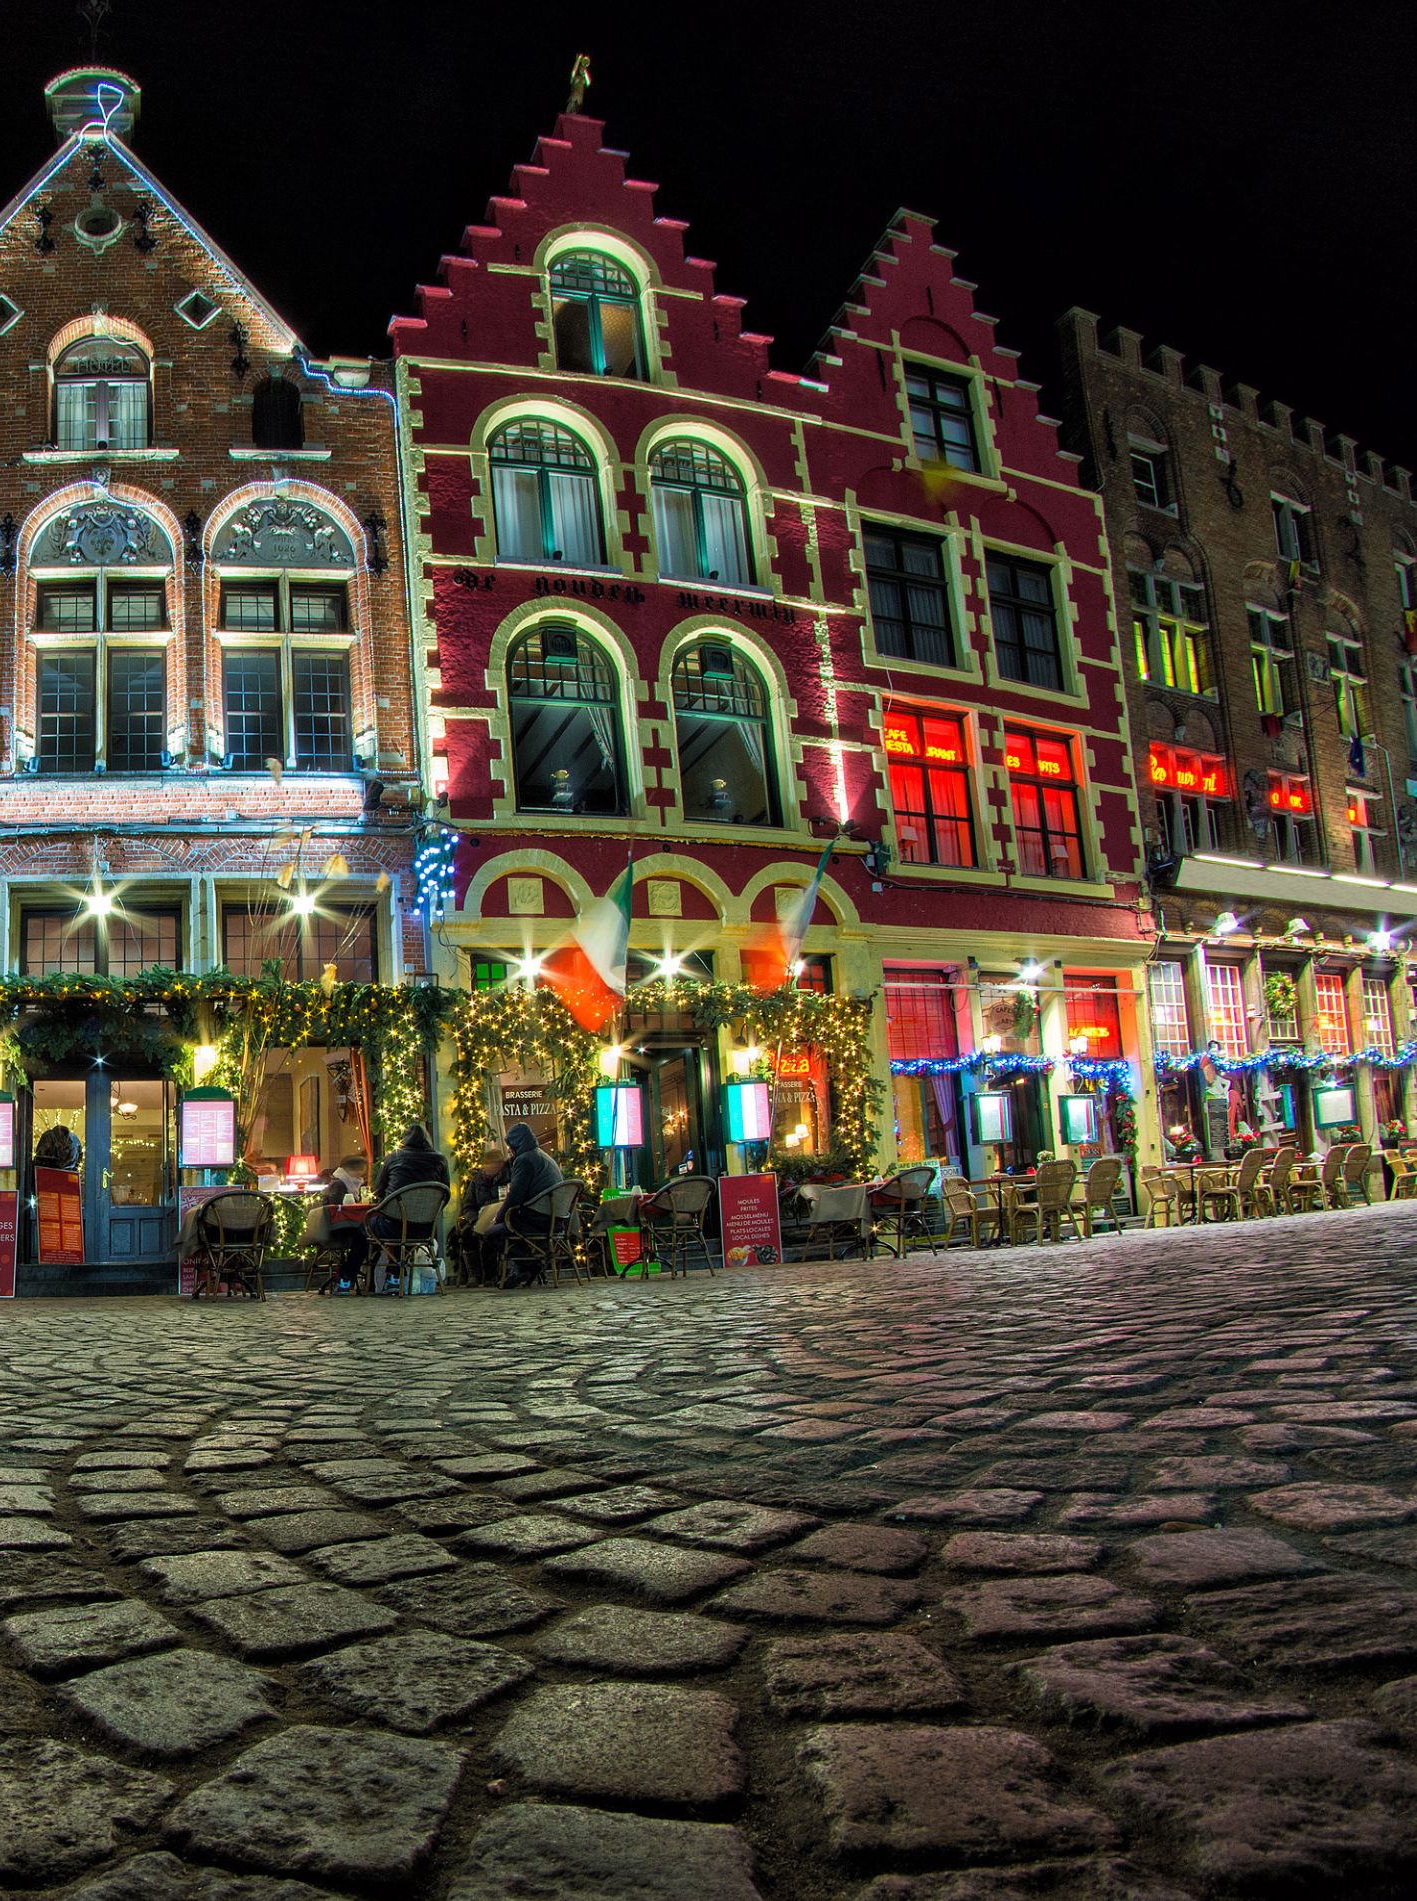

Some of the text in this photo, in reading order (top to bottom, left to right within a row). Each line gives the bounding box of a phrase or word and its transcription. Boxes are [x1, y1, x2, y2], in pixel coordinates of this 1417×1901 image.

[505, 1090, 543, 1099] BRASSERIE
[522, 1103, 529, 1116] &
[530, 1103, 557, 1115] PIZZA
